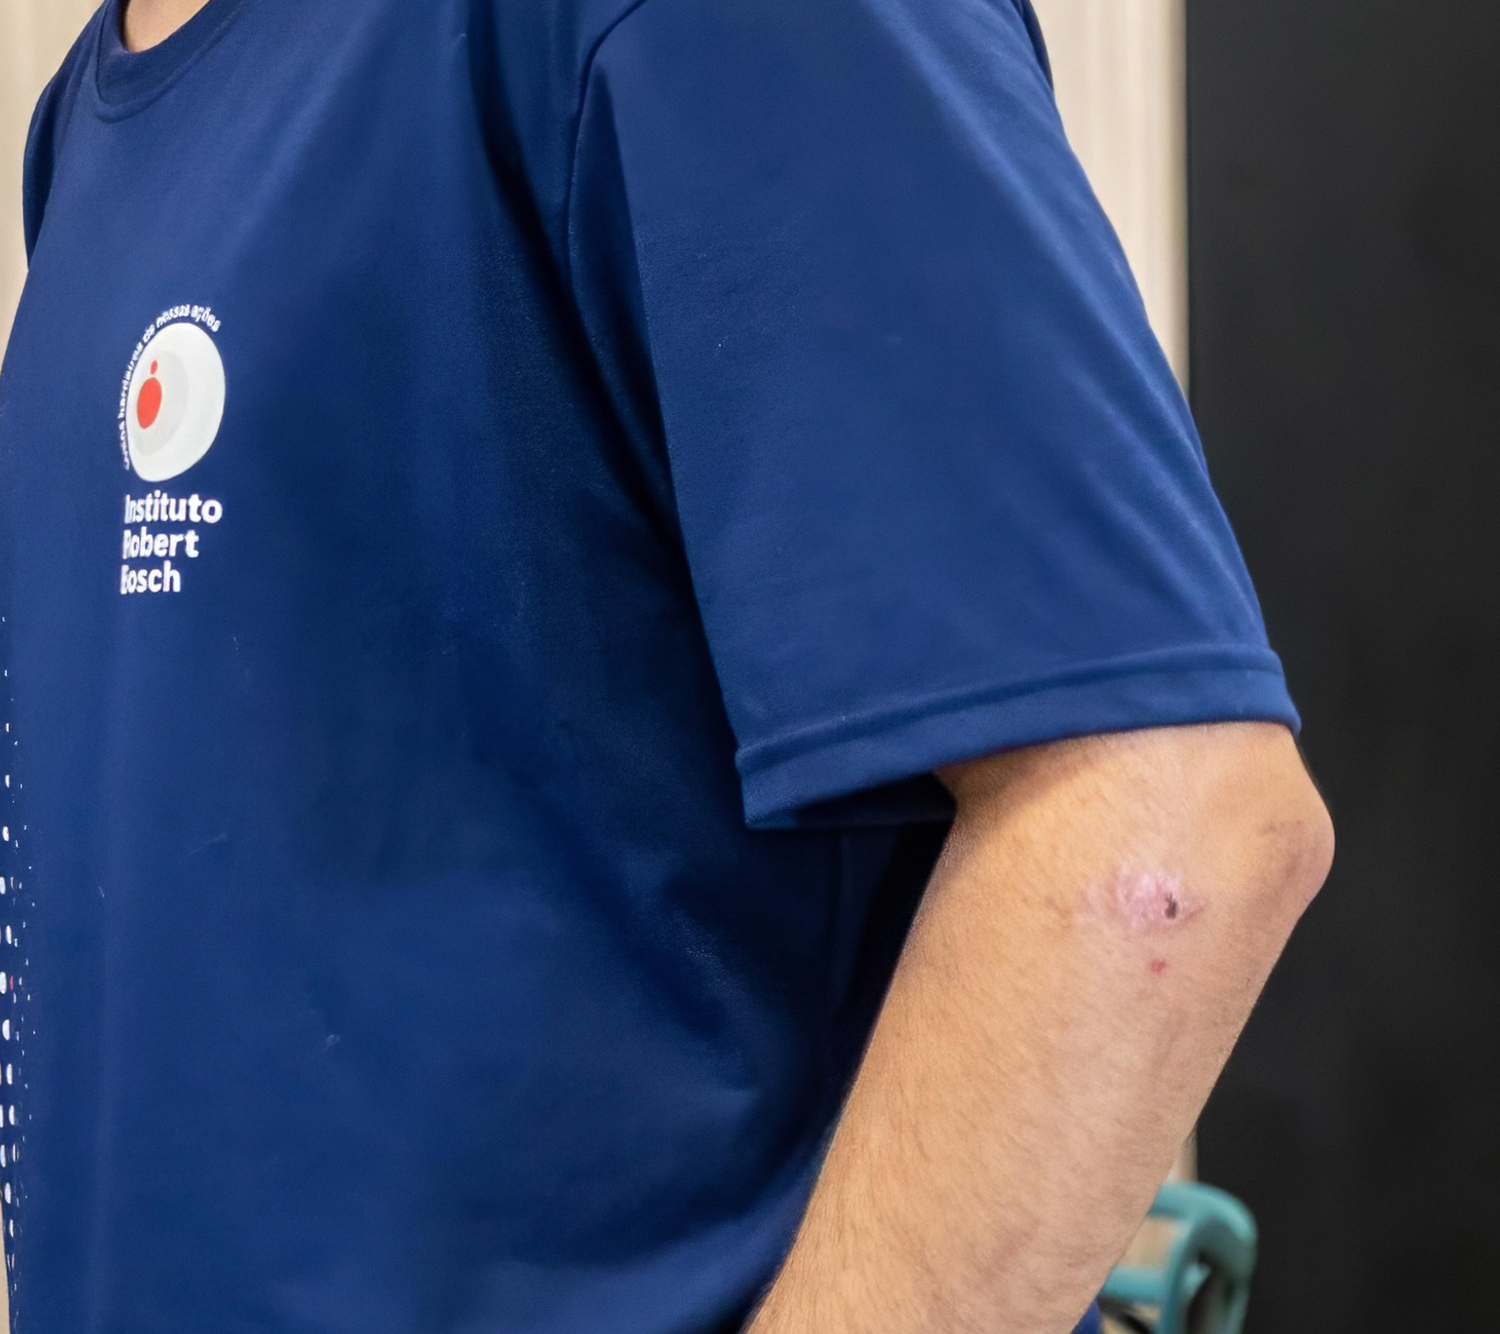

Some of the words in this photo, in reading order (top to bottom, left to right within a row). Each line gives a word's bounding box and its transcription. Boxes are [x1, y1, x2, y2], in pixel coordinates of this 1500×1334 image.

[124, 489, 223, 524] Instituto
[122, 526, 199, 559] Robert
[120, 560, 181, 595] Bosch
